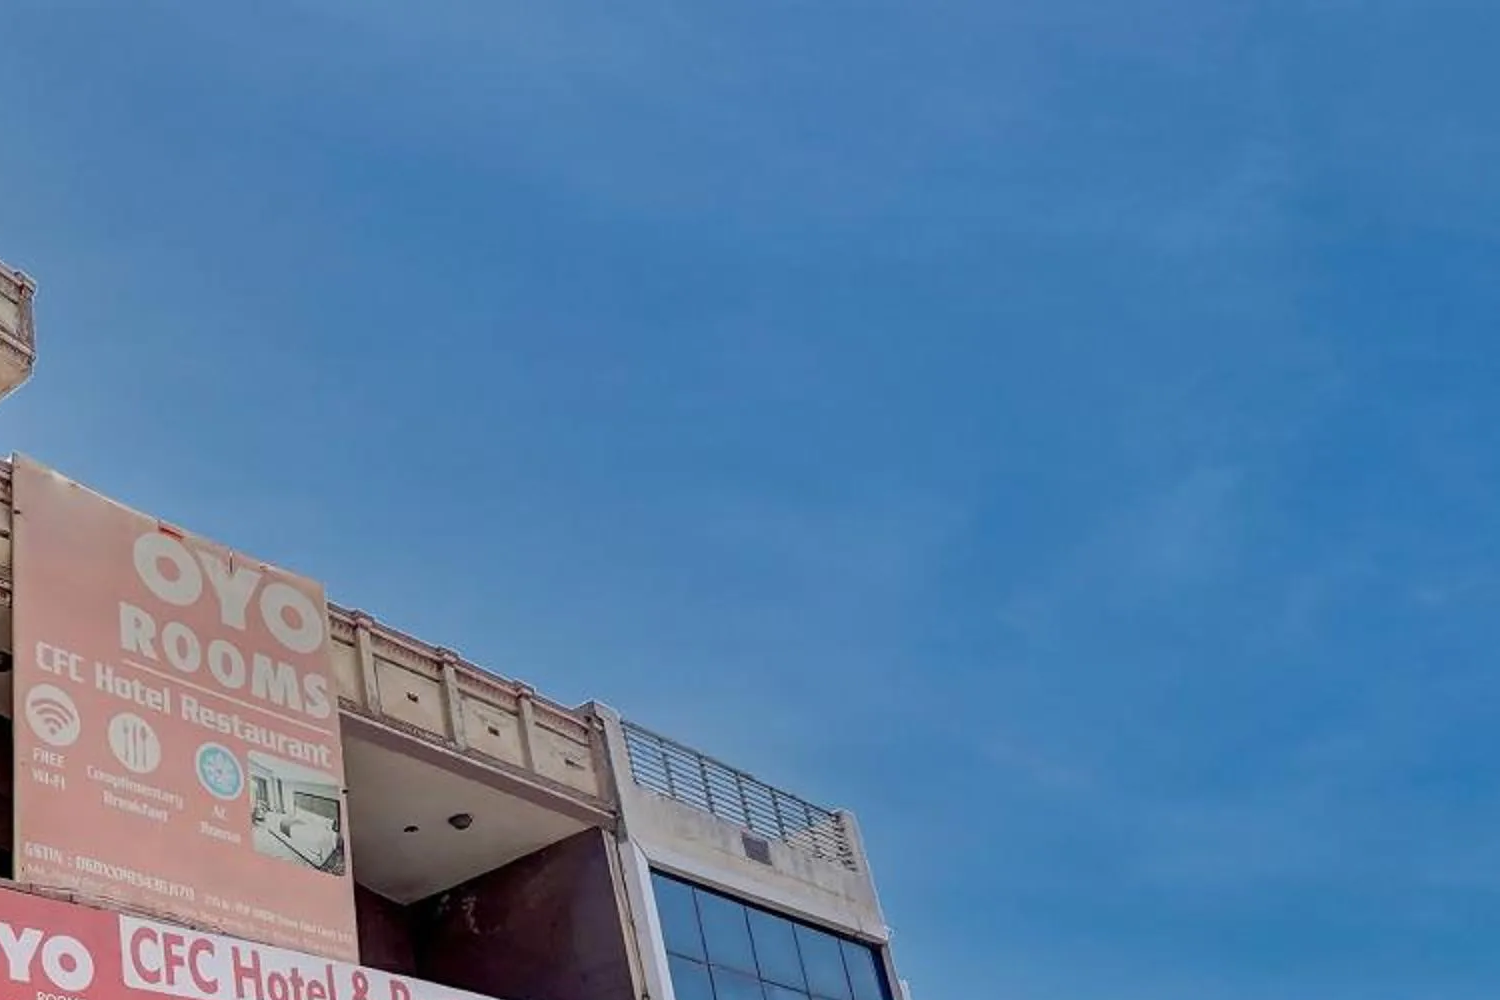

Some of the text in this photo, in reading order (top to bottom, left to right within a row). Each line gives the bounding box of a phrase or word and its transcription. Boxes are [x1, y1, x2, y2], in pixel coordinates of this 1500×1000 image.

[134, 531, 324, 653] OYO
[35, 641, 332, 768] CFC Hotel Restaurant
[119, 600, 331, 719] ROOMS
[33, 747, 66, 768] FREE
[130, 926, 219, 995] CFC
